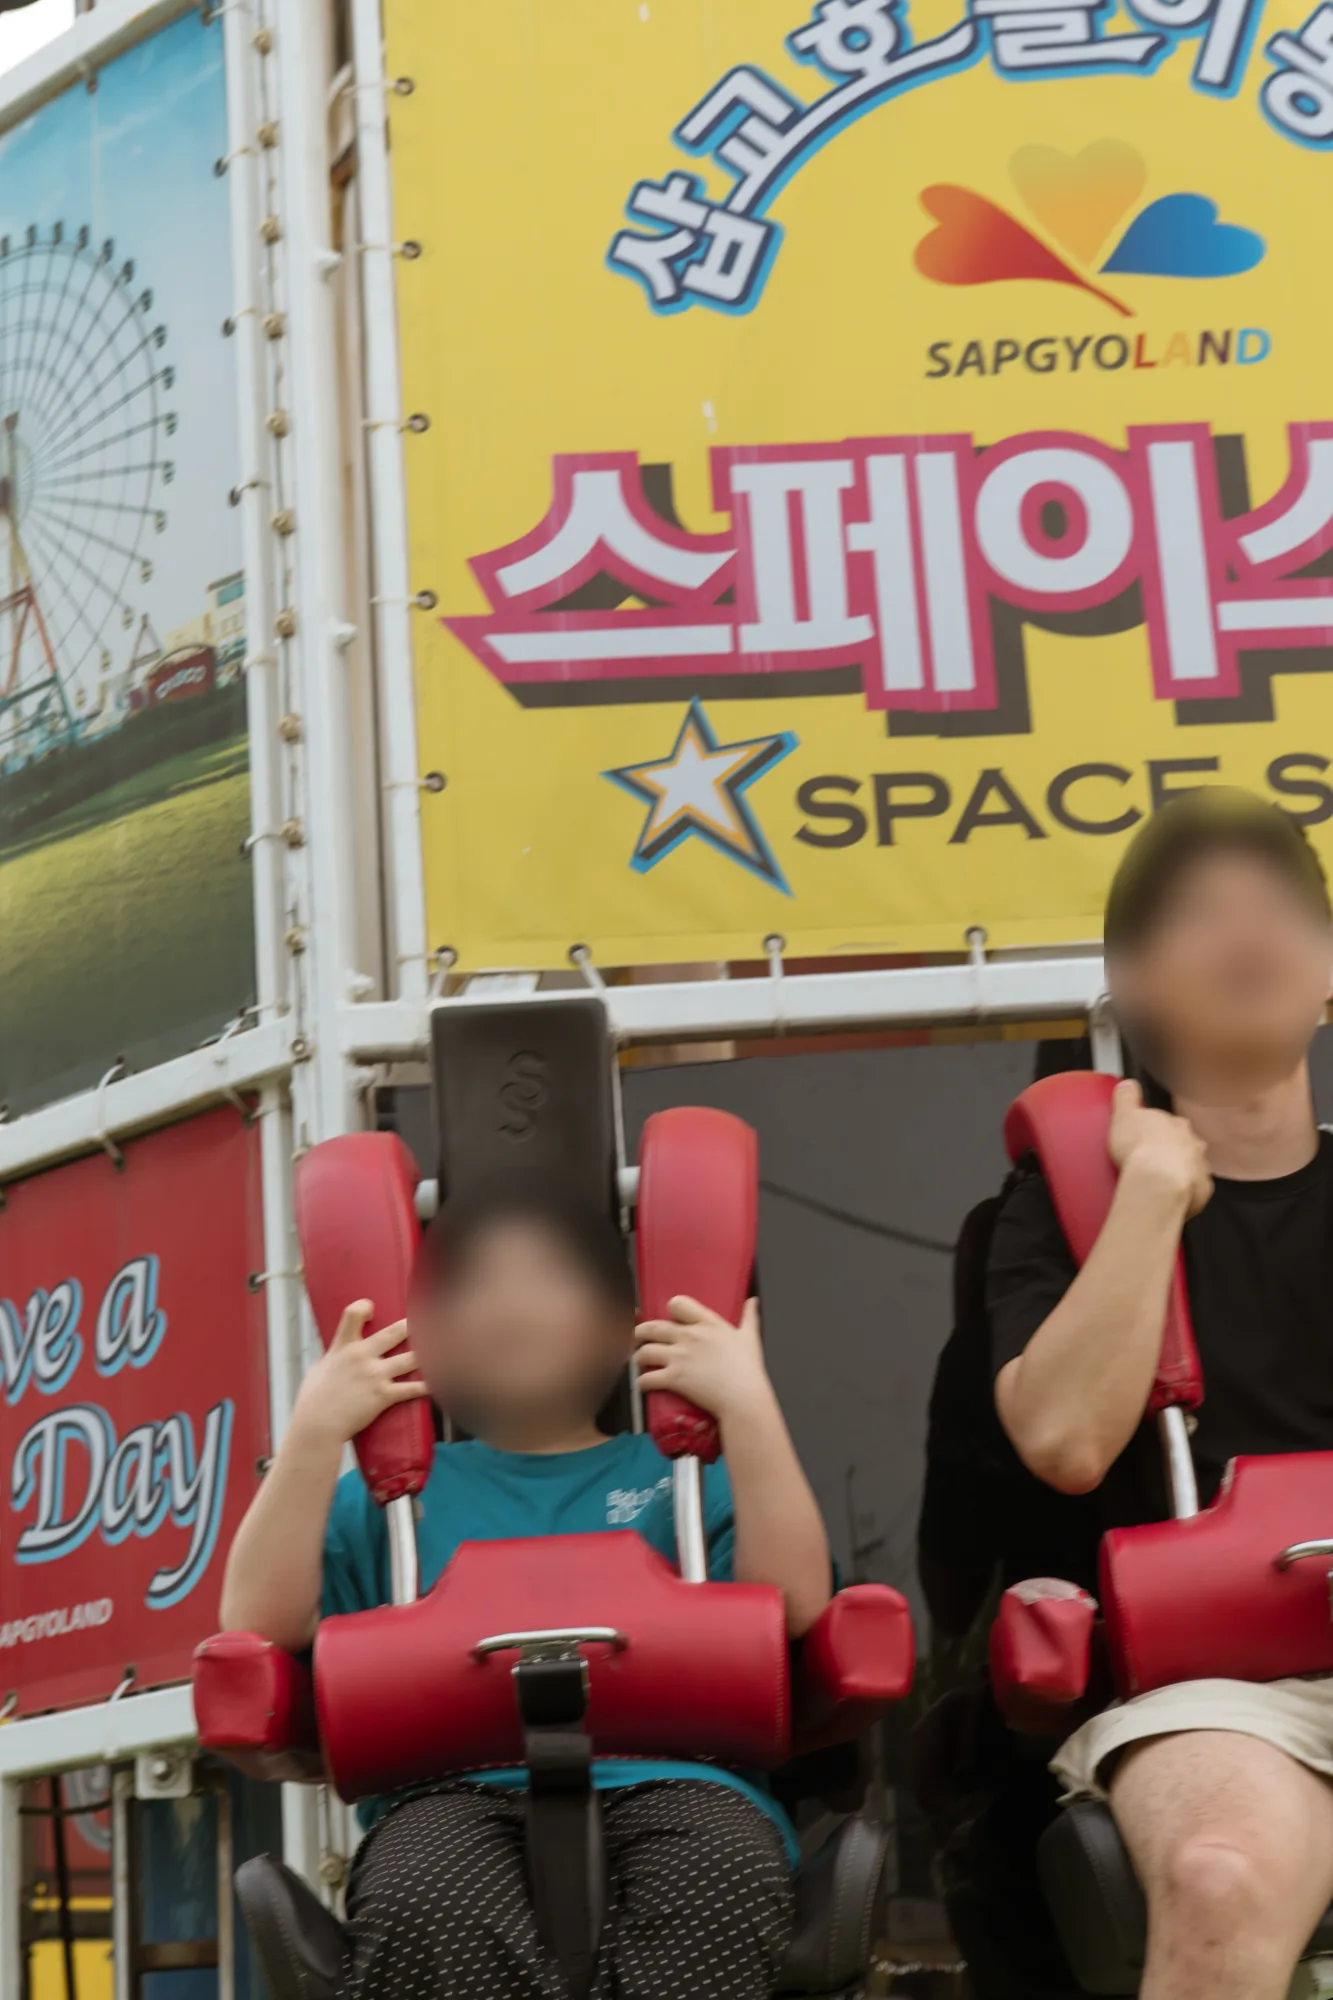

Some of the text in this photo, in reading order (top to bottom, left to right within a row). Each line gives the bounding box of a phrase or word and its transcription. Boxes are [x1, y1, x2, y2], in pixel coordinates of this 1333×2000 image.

[924, 327, 1272, 379] SAPGYOLAND
[95, 1253, 167, 1377] a
[10, 1398, 235, 1610] Day
